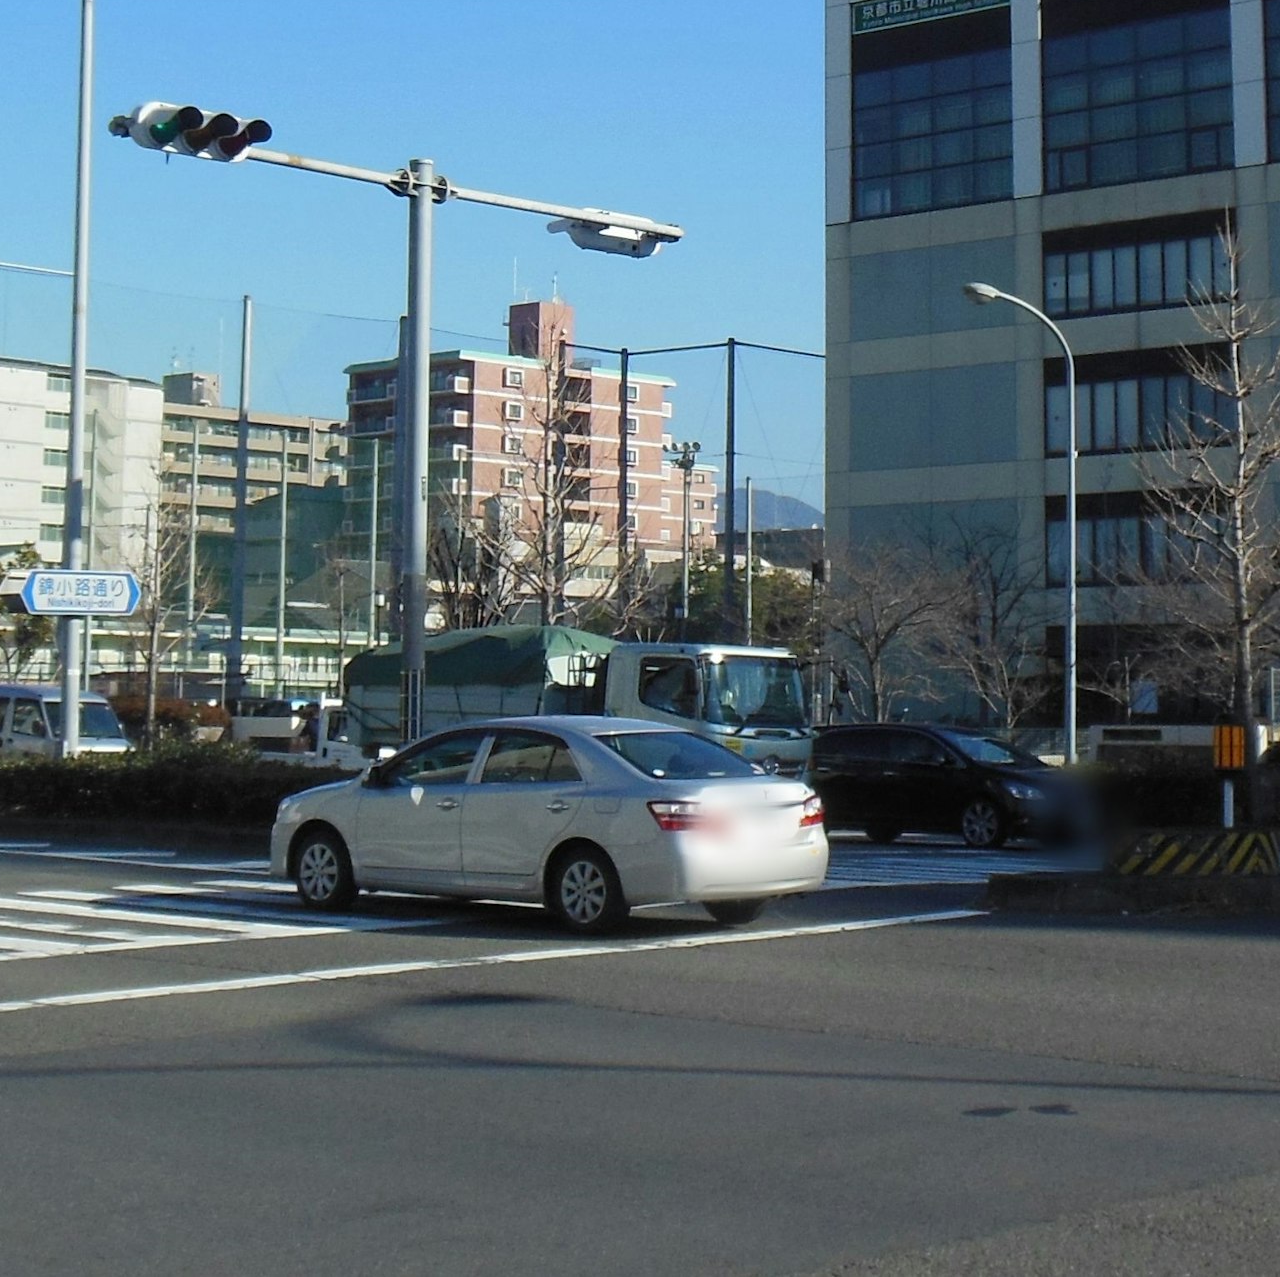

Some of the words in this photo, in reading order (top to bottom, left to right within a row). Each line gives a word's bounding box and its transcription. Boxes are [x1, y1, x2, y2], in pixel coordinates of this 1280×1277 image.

[39, 578, 124, 597] 錦小路通り
